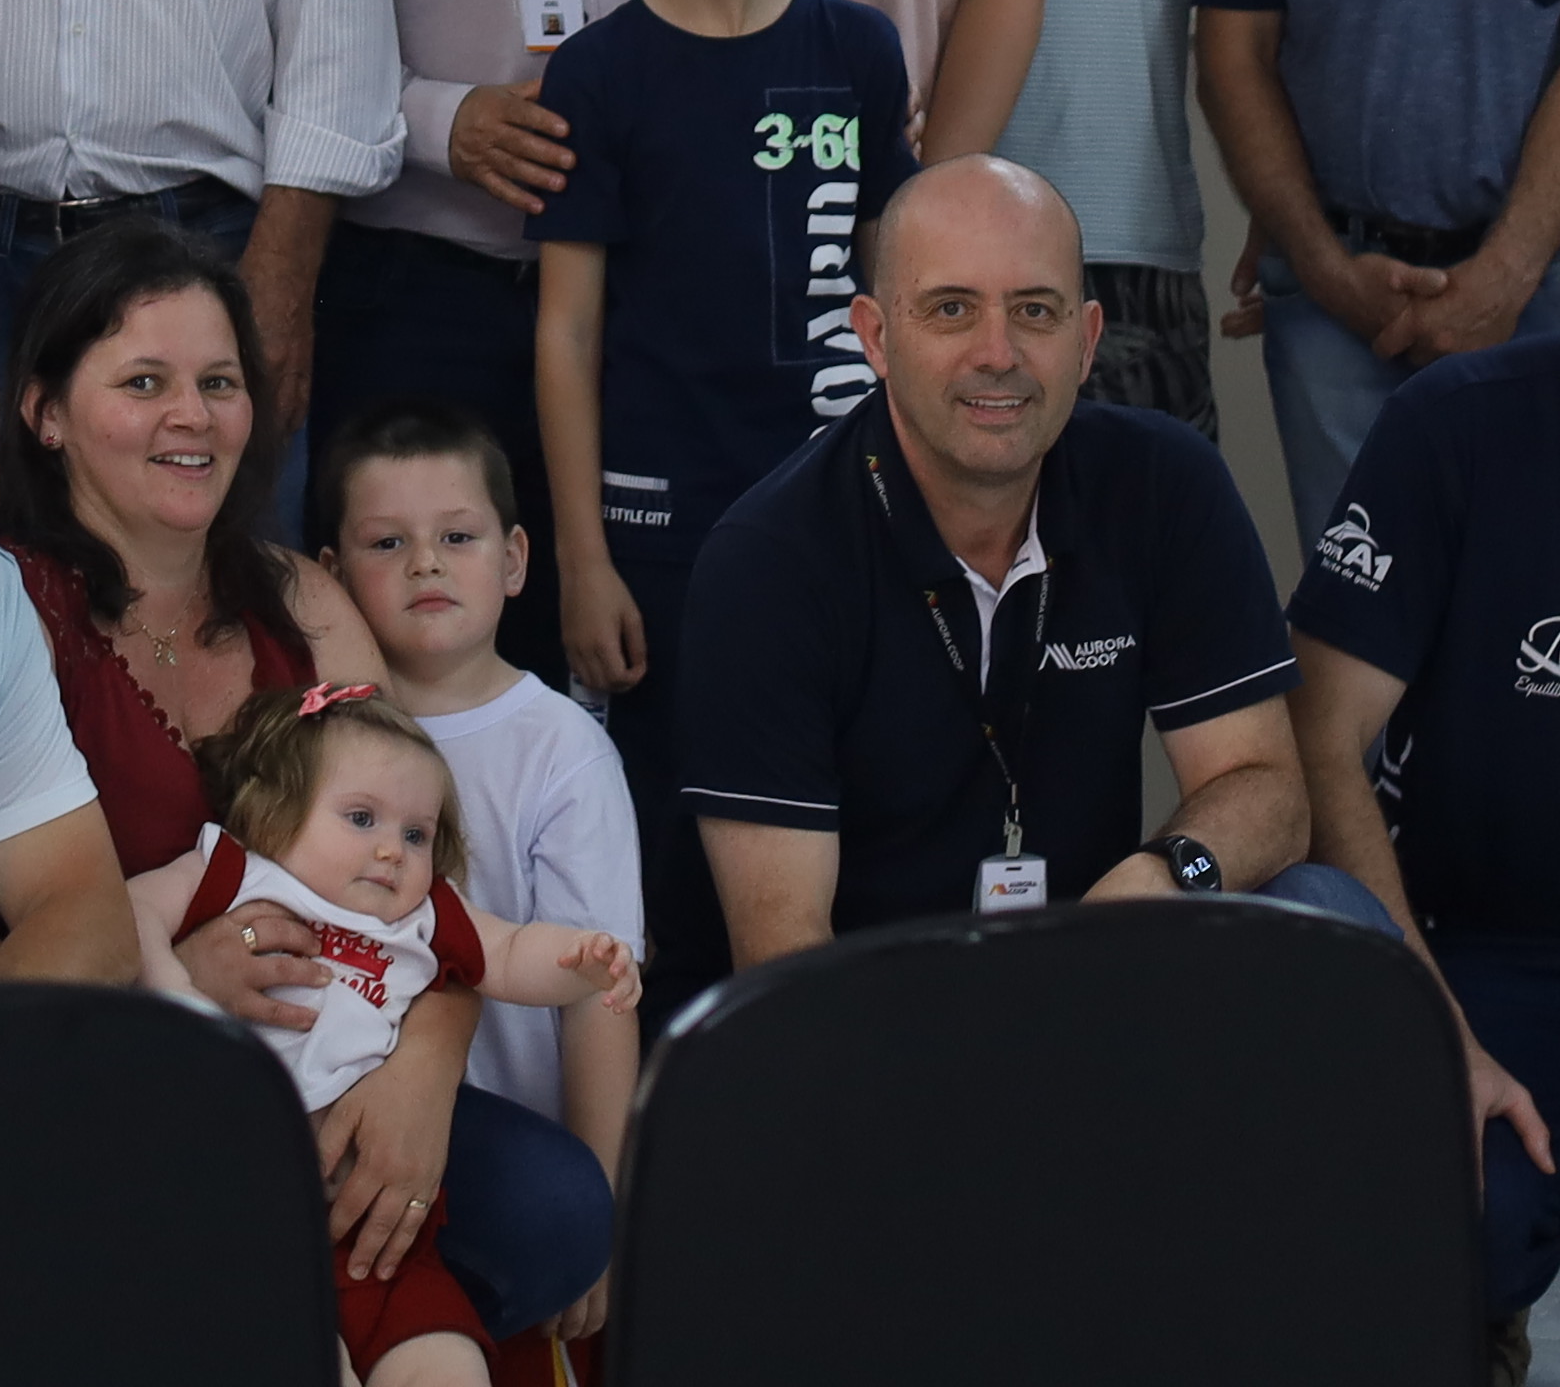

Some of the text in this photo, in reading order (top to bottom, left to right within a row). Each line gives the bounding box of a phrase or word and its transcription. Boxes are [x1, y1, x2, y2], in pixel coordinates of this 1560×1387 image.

[610, 507, 643, 523] STYLE
[644, 511, 672, 526] CITY
[1341, 542, 1393, 583] A1
[931, 607, 965, 672] AURORA COOP
[1074, 634, 1136, 657] AURORA
[1076, 650, 1119, 670] COOP
